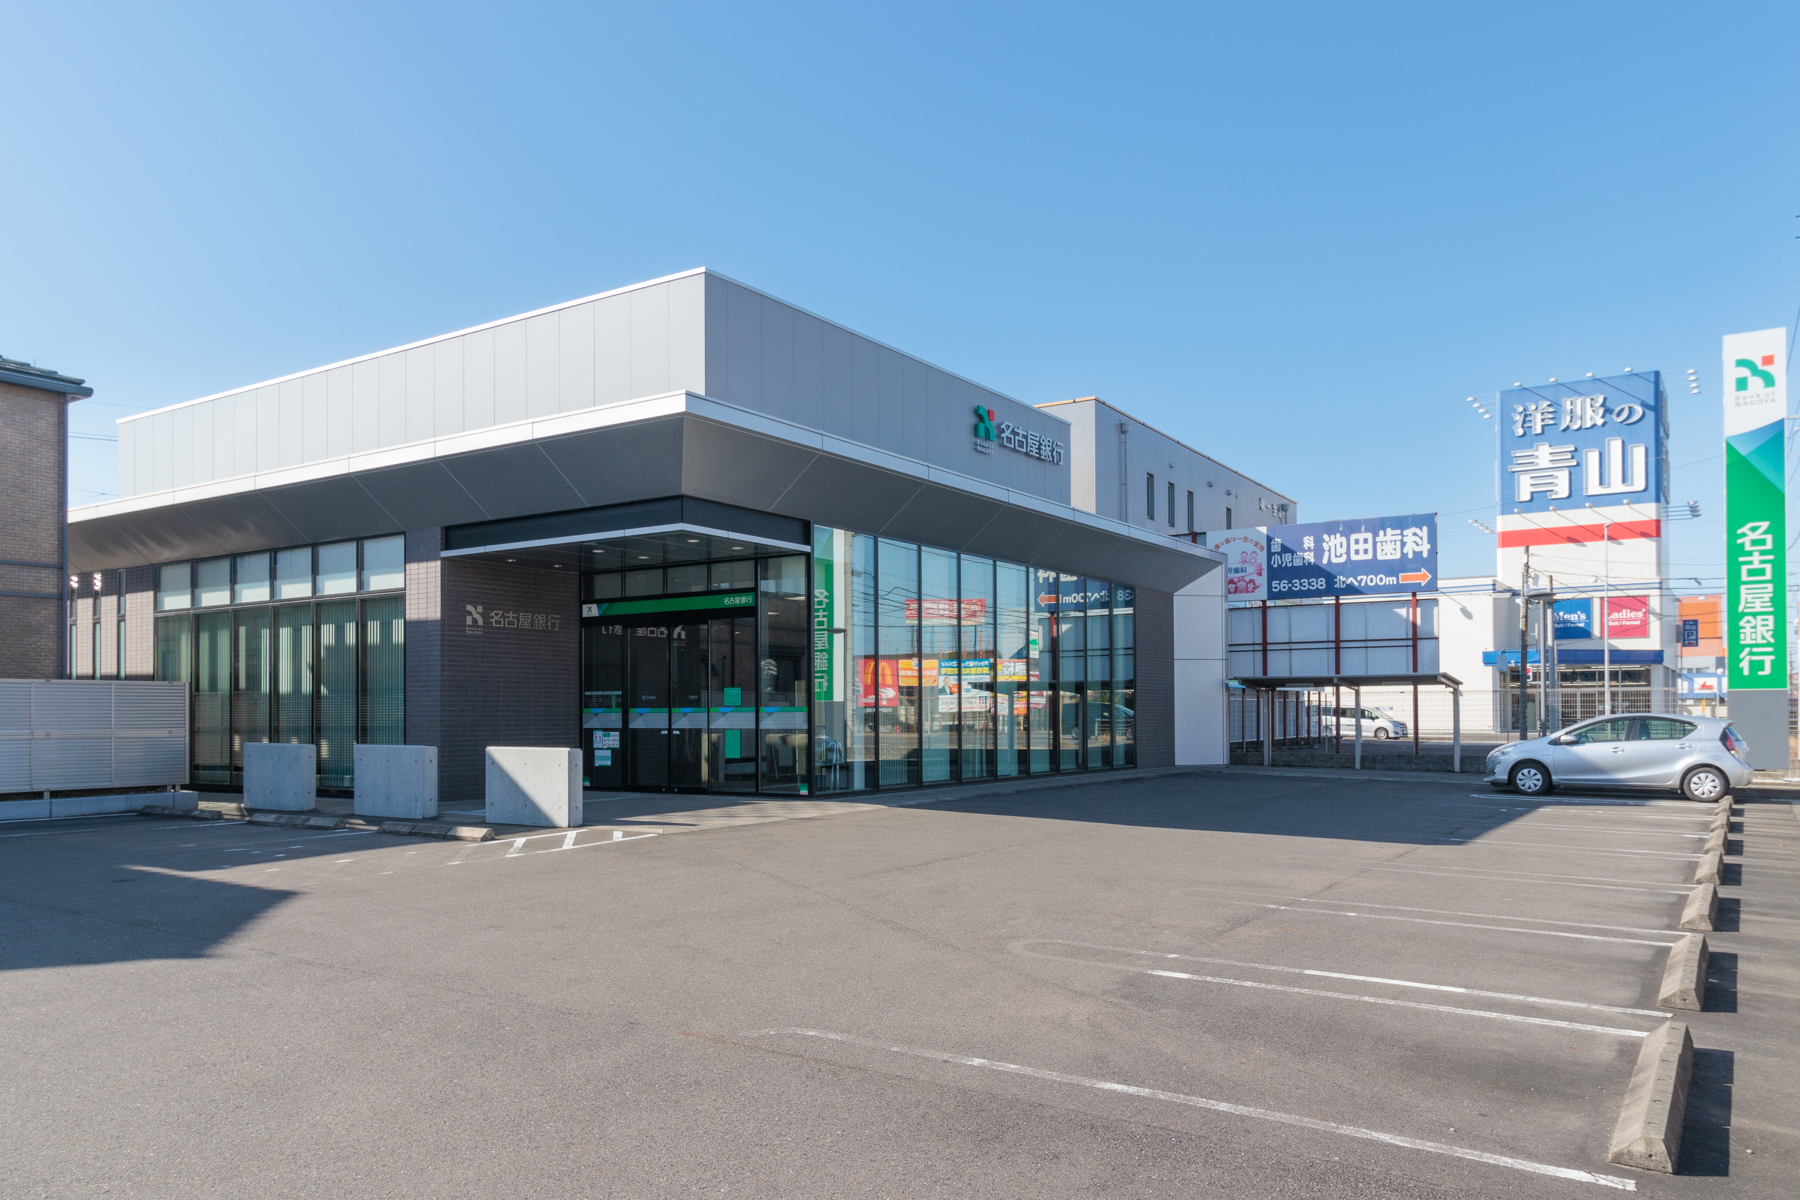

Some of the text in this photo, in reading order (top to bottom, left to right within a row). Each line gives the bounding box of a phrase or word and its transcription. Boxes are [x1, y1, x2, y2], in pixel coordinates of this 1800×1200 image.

[1735, 398, 1776, 407] NAGOYA
[1511, 394, 1645, 437] 洋服の
[1001, 421, 1064, 465] 名古屋銀行
[1508, 437, 1647, 502] 青山
[1213, 536, 1266, 552] 康な歯は一生の宝物
[1270, 535, 1315, 552] 歯 科
[1322, 525, 1431, 565] 池田歯科
[1270, 551, 1315, 568] 小児歯科
[1272, 574, 1397, 592] 56-3338 北へ700m
[724, 595, 752, 605] 名古屋銀行
[1736, 521, 1776, 676] 名古屋銀行
[490, 610, 560, 631] 名古屋銀行
[1554, 611, 1587, 621] Men's
[1687, 631, 1694, 639] P
